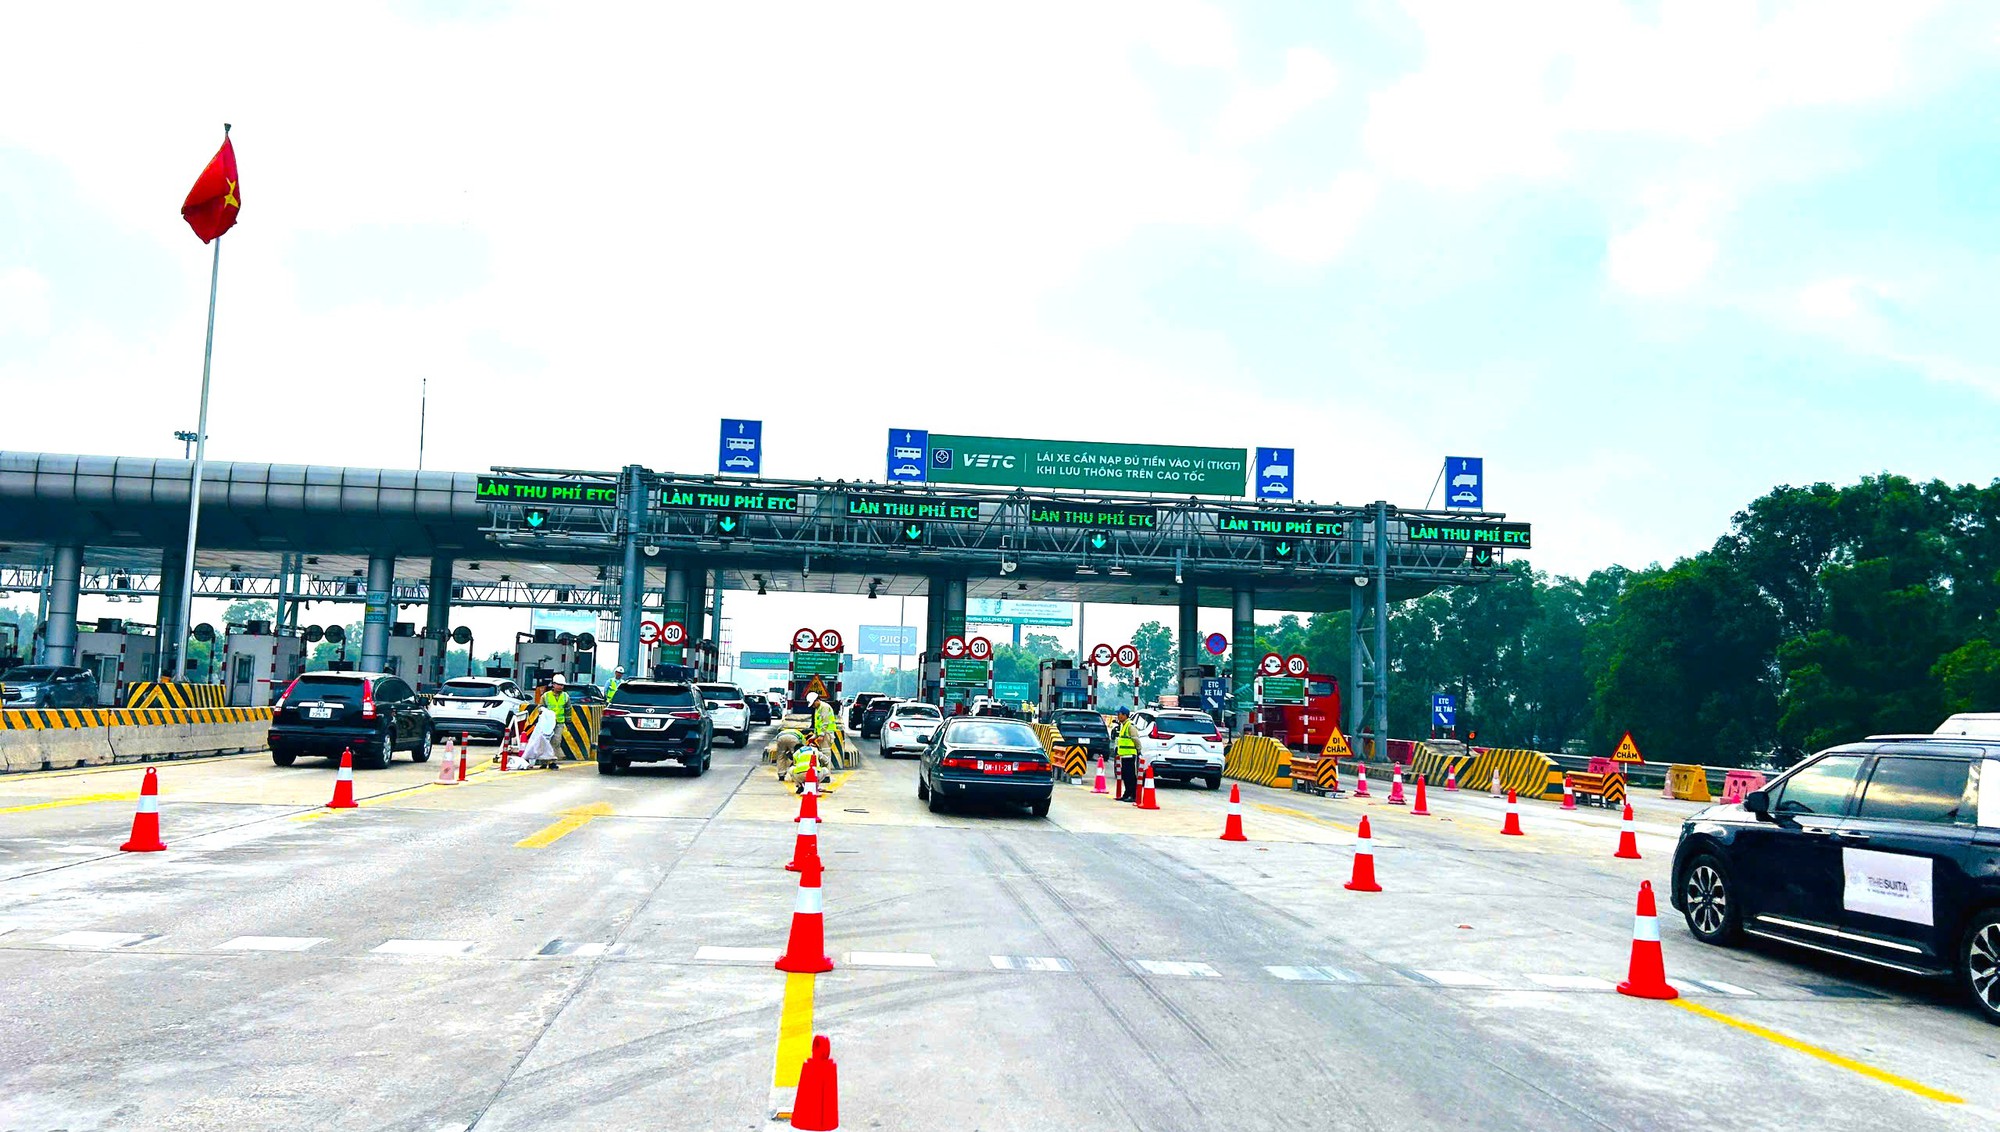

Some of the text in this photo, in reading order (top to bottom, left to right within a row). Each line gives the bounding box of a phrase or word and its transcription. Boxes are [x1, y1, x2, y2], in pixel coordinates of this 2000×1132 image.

[963, 454, 1016, 468] VETC
[1037, 451, 1053, 462] LÁI
[1057, 454, 1070, 462] XE
[1100, 456, 1121, 467] NẠP
[1168, 458, 1190, 468] VÀO
[1194, 458, 1204, 468] VÍ
[1207, 460, 1241, 471] (TKGT)
[1037, 466, 1205, 481] KHI LƯU THÔNG TRÊN CAO TỐC
[478, 480, 616, 501] LÀN THU PHÍ ETC
[662, 488, 796, 510] LÀN THU PHÍ ETC
[850, 498, 977, 518] LÀN THU PHÍ ETC
[1032, 506, 1154, 526] LÀN THU PHÍ ETC
[1220, 516, 1342, 536] LÀN THU PHÍ ETC
[1411, 523, 1529, 543] LÀN THU PHÍ ETC
[667, 628, 679, 639] 30
[824, 635, 836, 646] 30
[974, 643, 985, 653] 30
[1121, 651, 1133, 661] 30
[1291, 660, 1302, 671] 30
